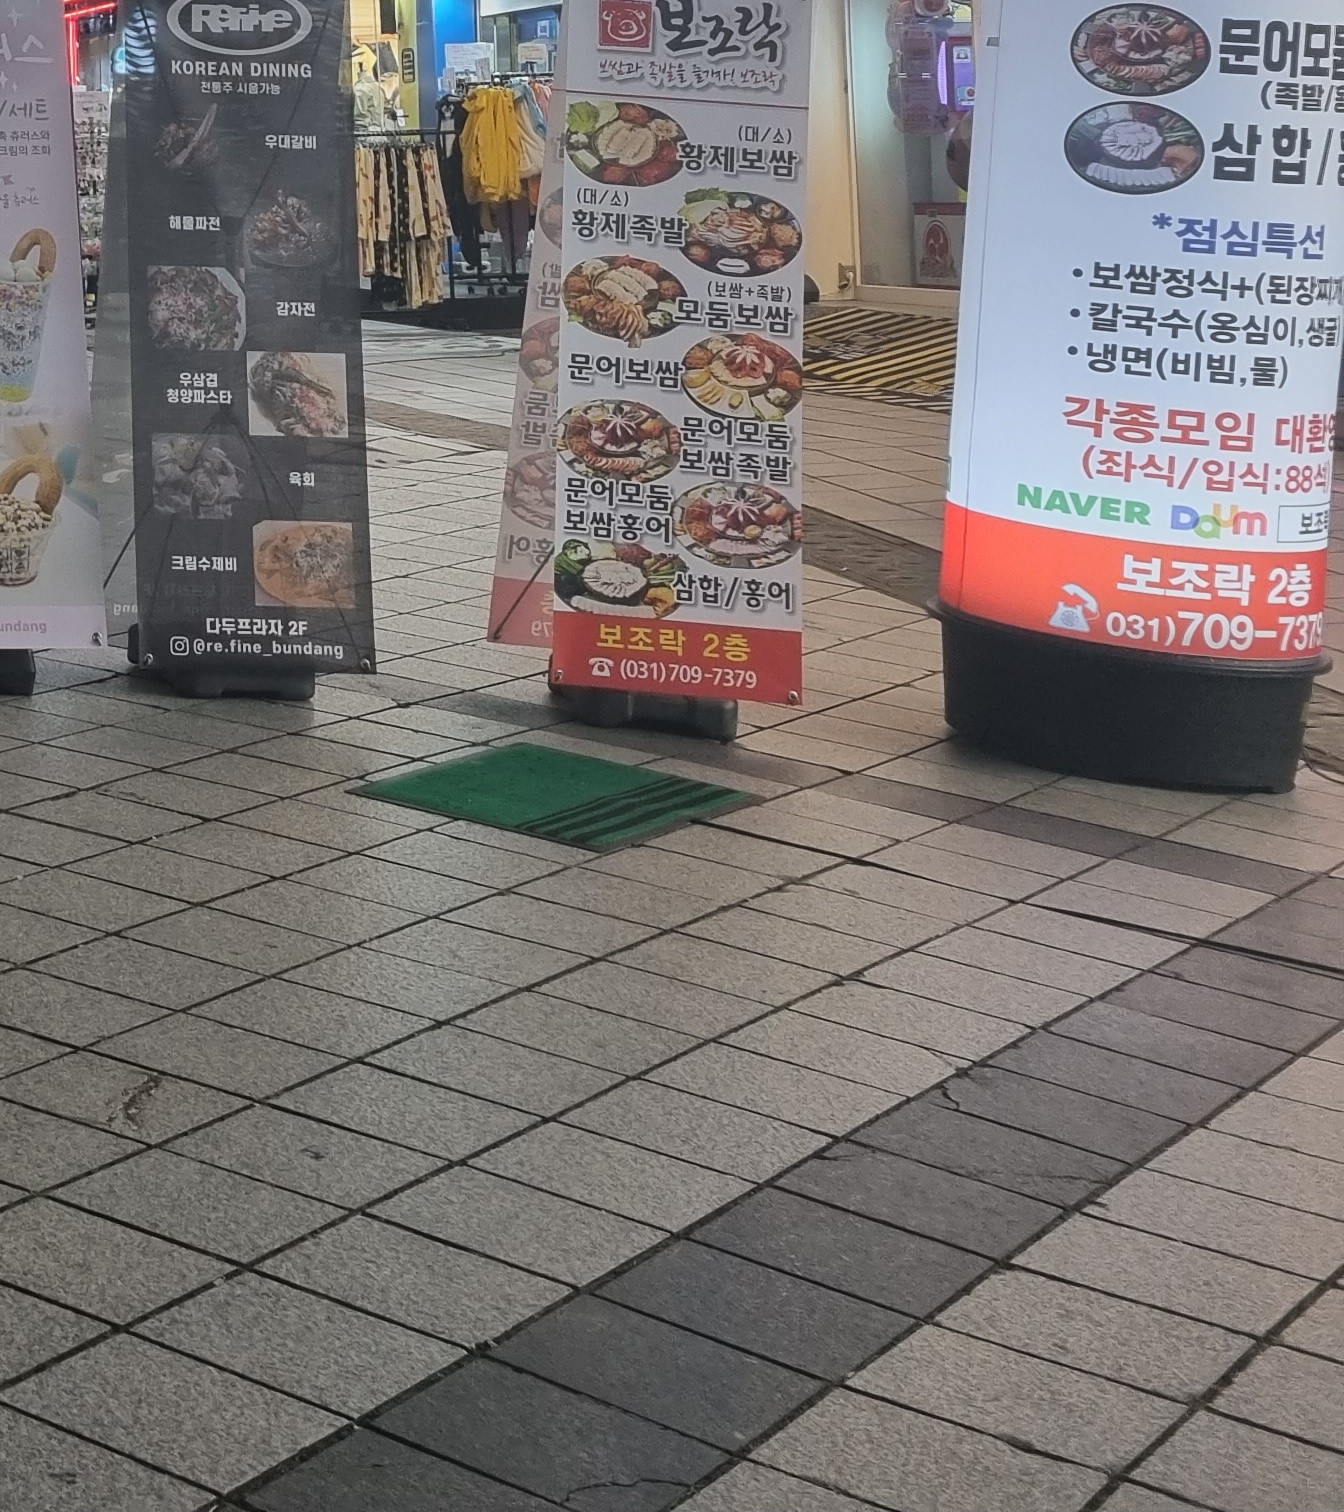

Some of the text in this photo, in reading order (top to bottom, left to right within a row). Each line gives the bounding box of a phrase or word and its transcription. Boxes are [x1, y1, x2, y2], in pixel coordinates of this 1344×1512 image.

[171, 60, 312, 78] KOREAN DINING
[264, 134, 318, 151] 우대갈비
[738, 124, 793, 145] (대/소)
[678, 142, 798, 178] 황제보쌈
[576, 188, 630, 207] (대/소)
[169, 215, 221, 231] 해물파전
[572, 209, 687, 245] 황제족발
[707, 280, 792, 303] (보쌈+족발)
[276, 300, 315, 317] 감자전
[675, 297, 794, 334] 모둠보쌈
[568, 354, 684, 388] 문어보쌈
[1086, 342, 1288, 389] 냉면(비빔,물)
[179, 371, 218, 387] 우삼겹
[166, 388, 233, 405] 청양파스타
[679, 416, 792, 450] 문어모둠
[679, 449, 793, 481] 보쌈족발
[288, 471, 315, 488] 육회
[564, 478, 673, 511] 문어모둠
[563, 509, 673, 542] 보쌈홍어
[171, 555, 238, 573] 크림수제비
[673, 574, 793, 610] 삼합/홍어
[1117, 553, 1313, 608] 보조락 2층
[206, 617, 308, 636] 다두프라자 2F
[193, 638, 344, 659] @re.fine_bundang
[597, 624, 751, 662] 보조락 2층
